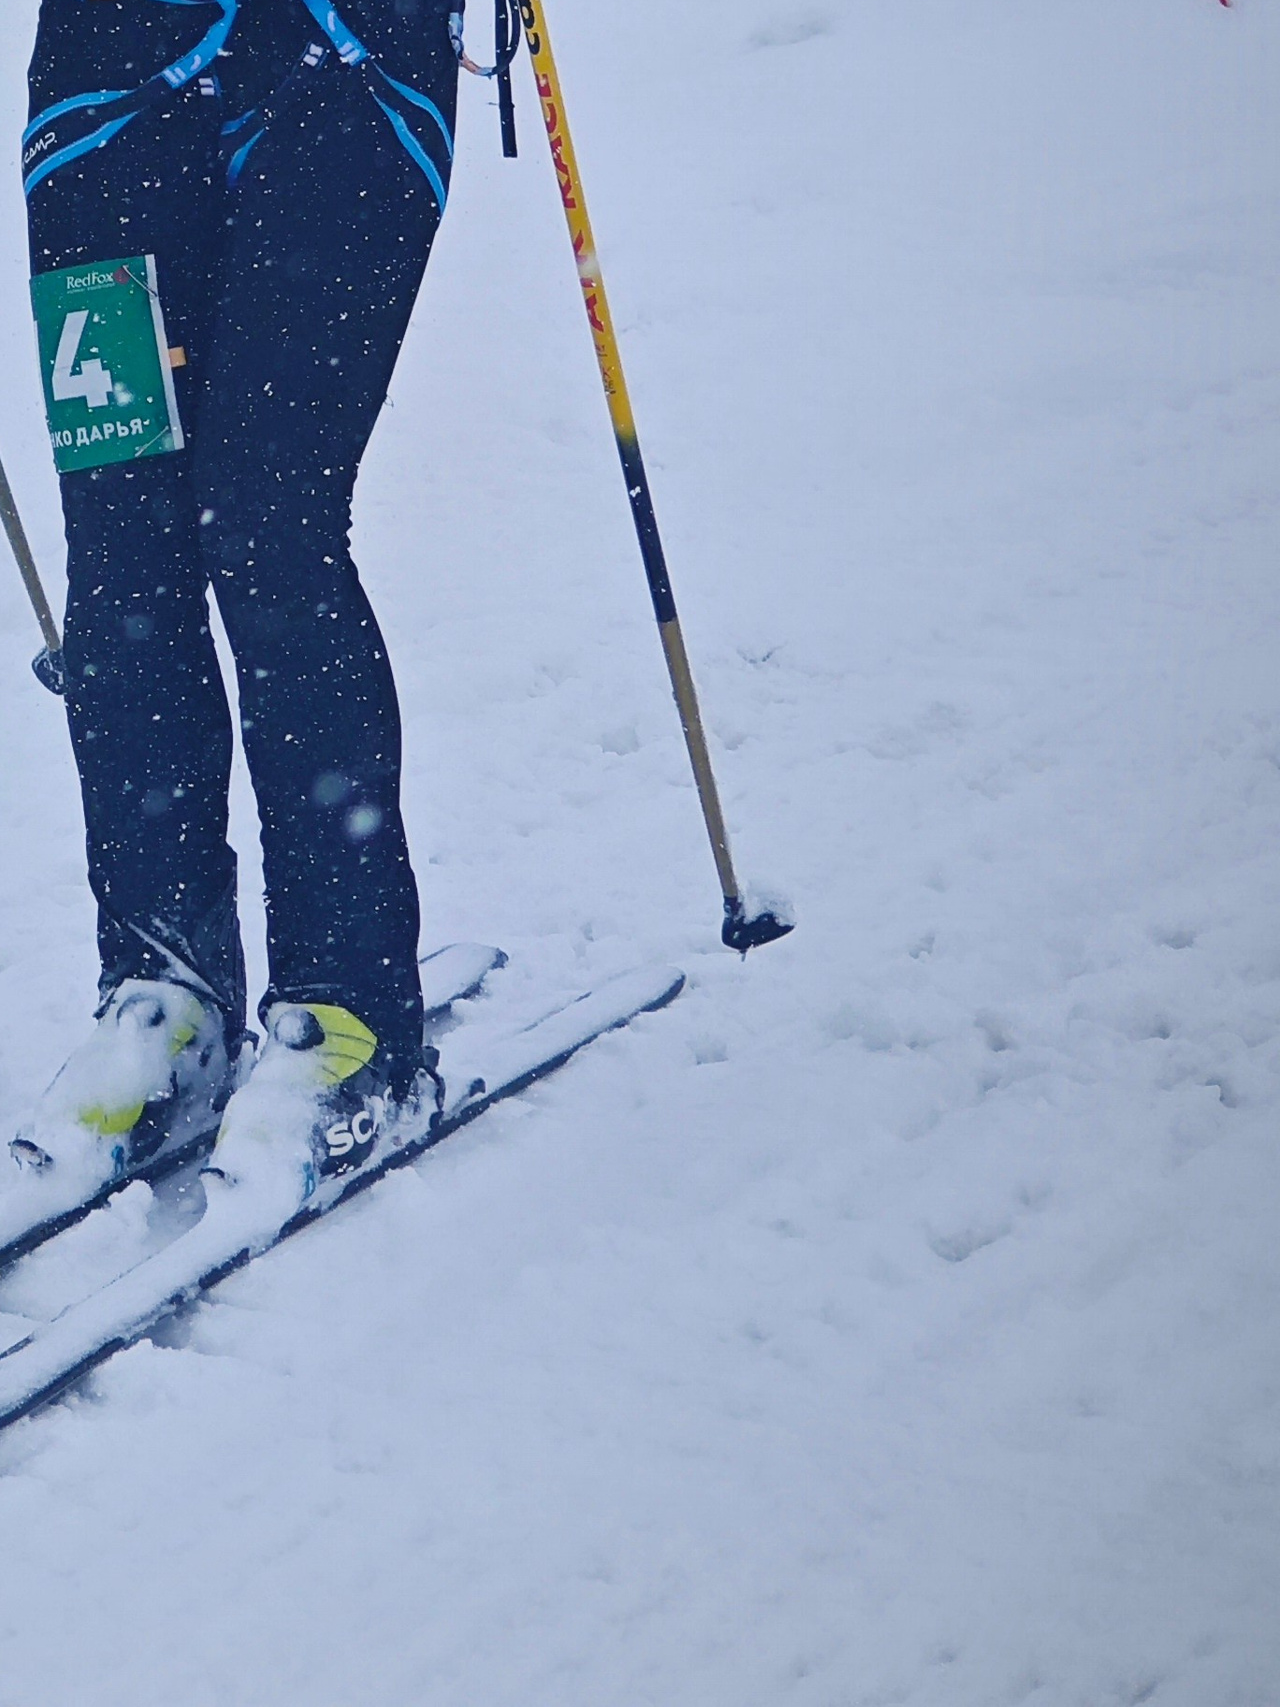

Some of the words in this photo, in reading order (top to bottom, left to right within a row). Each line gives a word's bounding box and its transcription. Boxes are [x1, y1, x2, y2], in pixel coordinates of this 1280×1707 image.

[24, 132, 56, 163] CAMP
[66, 271, 114, 290] RedFox
[52, 309, 113, 408] 4
[76, 418, 144, 447] ДАРЬЯ
